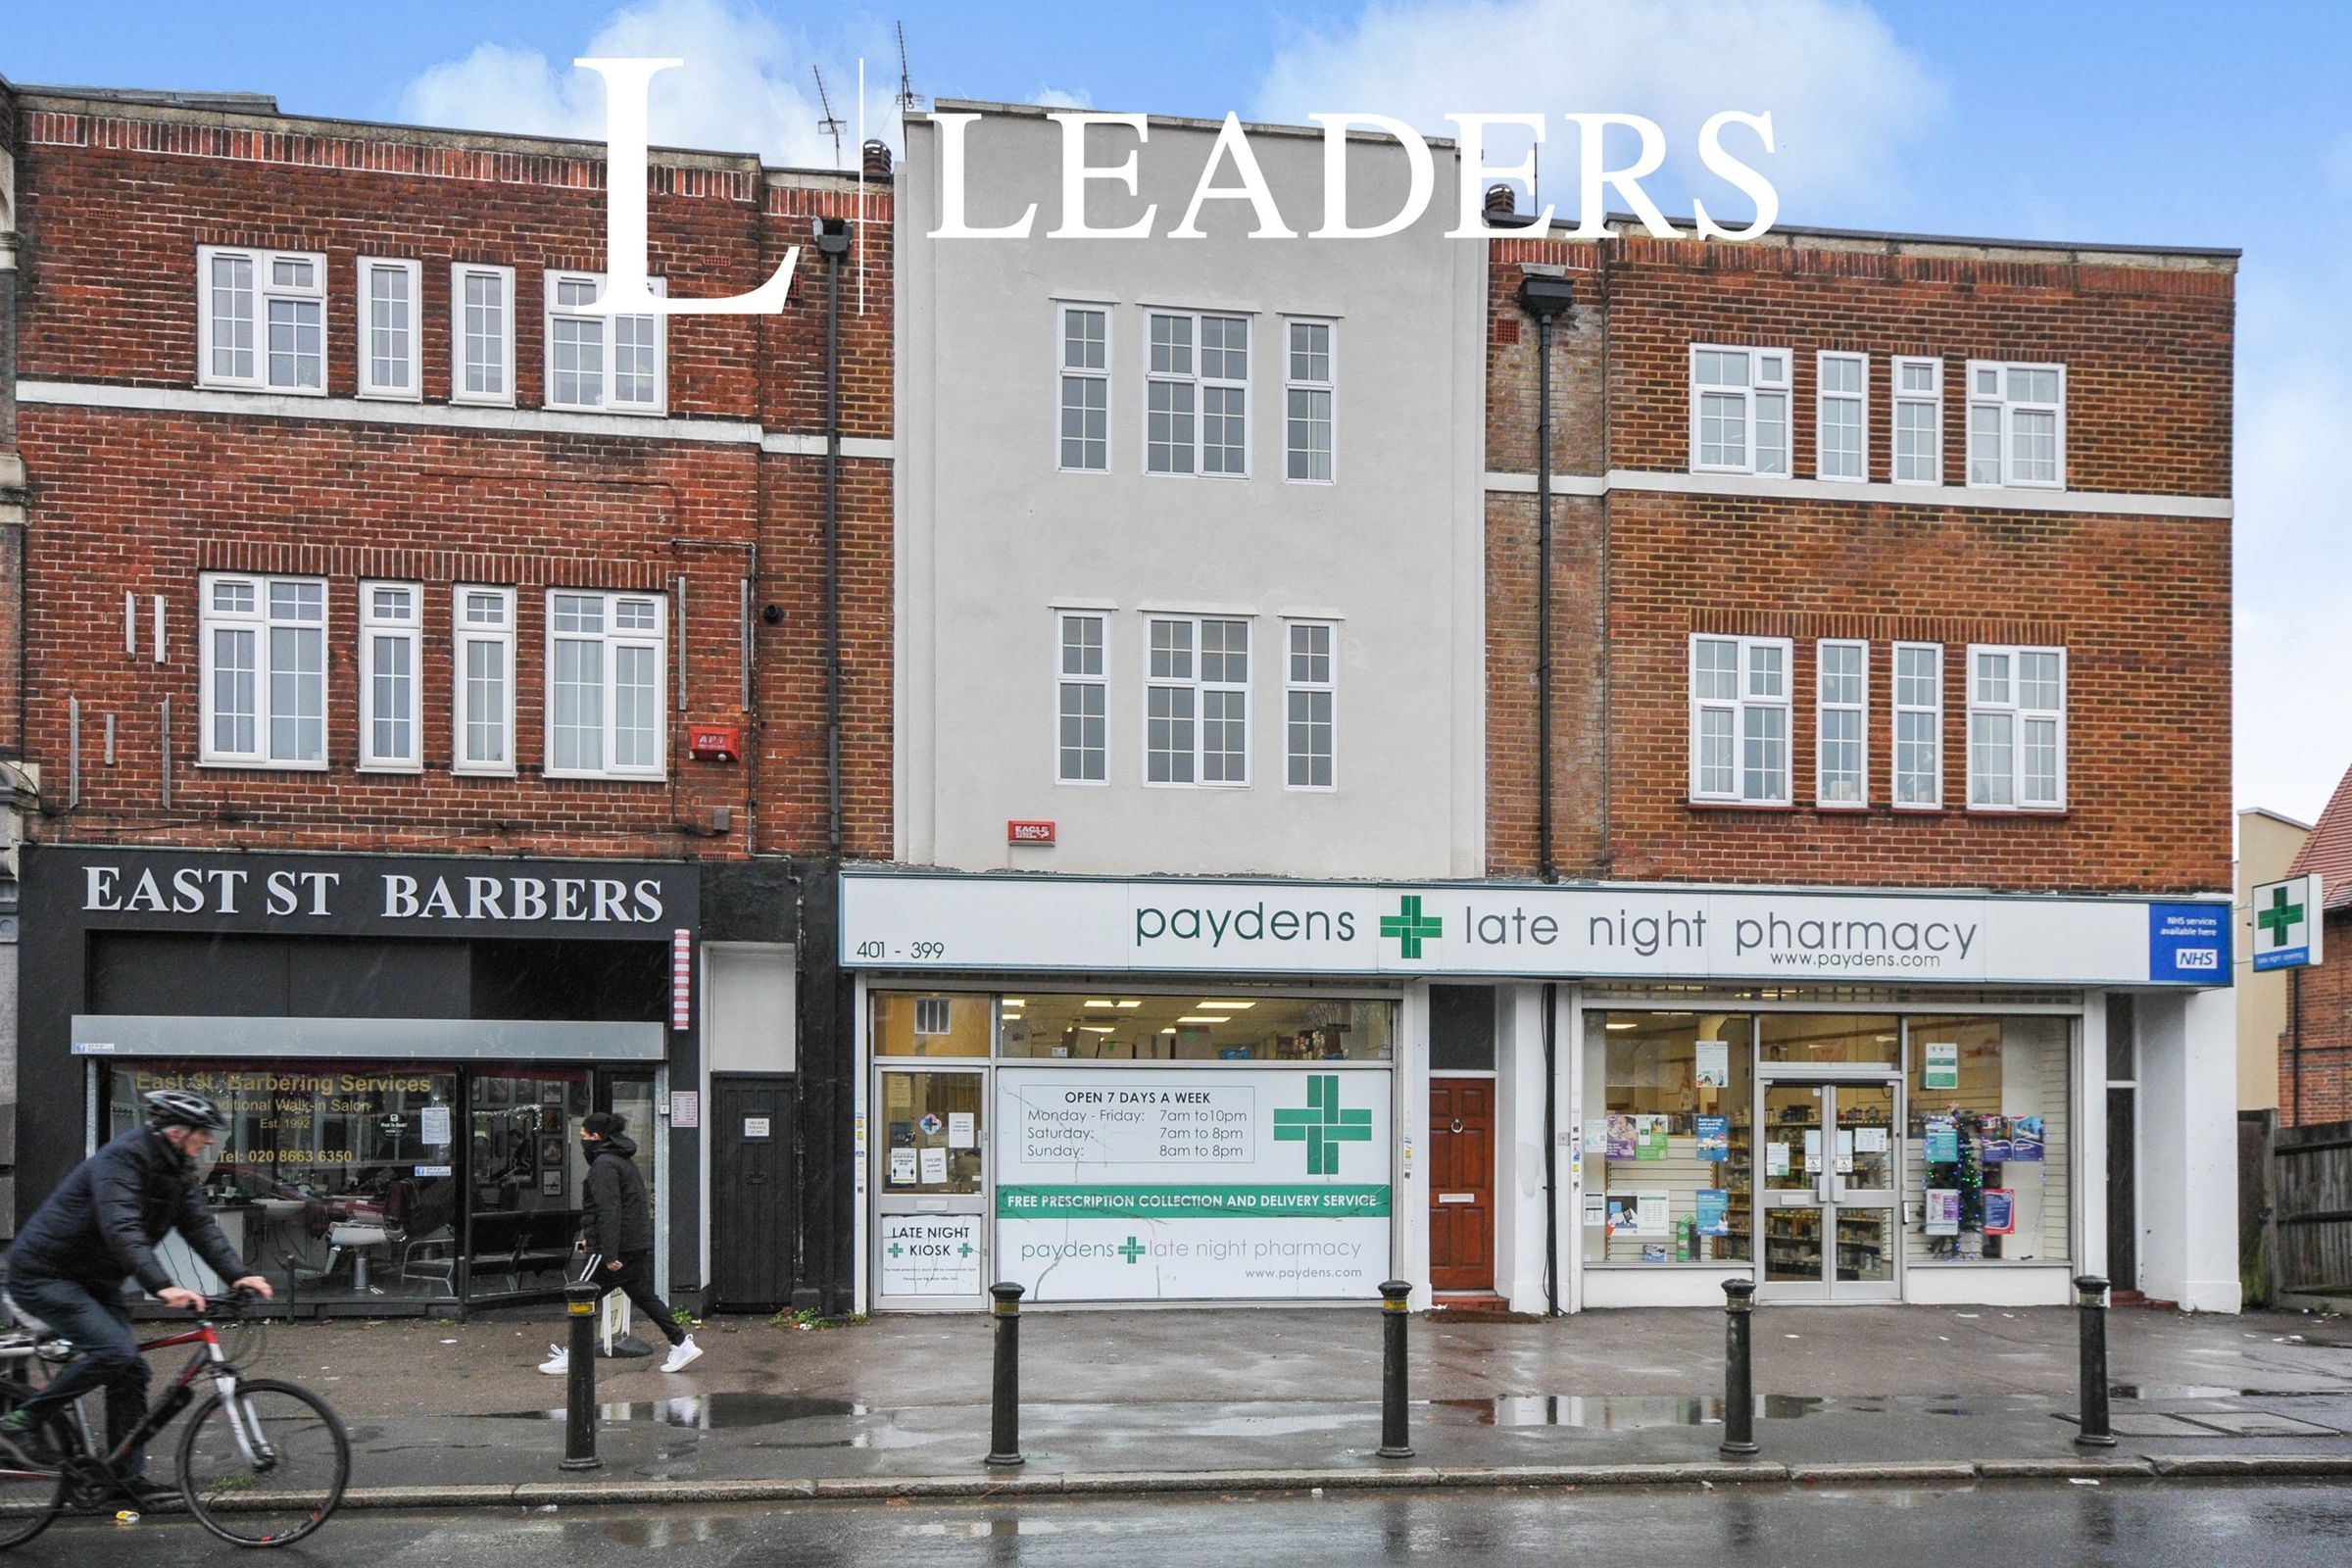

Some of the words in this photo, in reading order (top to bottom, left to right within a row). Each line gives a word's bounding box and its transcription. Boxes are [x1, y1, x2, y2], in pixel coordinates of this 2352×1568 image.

[81, 866, 247, 913] EAST
[267, 871, 340, 916] ST
[381, 874, 663, 924] BARBERS
[2167, 916, 2184, 925] NHS
[2186, 917, 2218, 926] services
[1136, 902, 1355, 948] paydens
[1466, 906, 1559, 945] late
[1590, 909, 1706, 956] night
[1737, 911, 1977, 958] pharmacy
[2160, 927, 2197, 936] available
[857, 941, 887, 959] 401
[910, 942, 945, 960] 399
[1770, 952, 1940, 969] www.paydens.com
[2180, 952, 2213, 965] NHS
[137, 1072, 183, 1091] East
[227, 1074, 334, 1095] Barbering
[340, 1075, 431, 1093] Services
[1064, 1092, 1102, 1103] OPEN
[1107, 1092, 1115, 1103] 7
[1119, 1092, 1156, 1103] DAYS
[1160, 1092, 1171, 1103] A
[1175, 1092, 1211, 1103] WEEK
[275, 1099, 326, 1111] Walk-in
[332, 1100, 370, 1112] Salon
[1027, 1109, 1087, 1123] Monday
[1100, 1109, 1146, 1123] Friday:
[1159, 1110, 1191, 1122] 7am
[284, 1118, 311, 1129] 1992
[1027, 1127, 1095, 1141] Saturday:
[1159, 1127, 1191, 1139] 7am
[1195, 1128, 1208, 1139] to
[1212, 1127, 1244, 1141] 8pm
[219, 1150, 244, 1162] Tel:
[248, 1150, 274, 1163] 020
[278, 1150, 314, 1163] 8663
[318, 1150, 353, 1163] 6350
[1027, 1145, 1084, 1158] Sunday:
[1159, 1145, 1191, 1156] 8am
[1195, 1146, 1208, 1156] to
[1212, 1145, 1244, 1158] 8pm
[1007, 1195, 1038, 1207] FREE
[1042, 1195, 1135, 1207] PRESCRIPTION
[1139, 1195, 1222, 1207] COLLECTION
[1226, 1195, 1257, 1207] AND
[1260, 1195, 1319, 1207] DELIVERY
[1323, 1195, 1376, 1207] SERVICE
[892, 1227, 922, 1239] LATE
[927, 1227, 970, 1239] NIGHT
[909, 1245, 951, 1256] KIOSK
[1021, 1240, 1114, 1262] paydens
[1150, 1240, 1189, 1256] late
[1196, 1239, 1249, 1261] night
[1254, 1239, 1362, 1261] pharmacy
[1245, 1267, 1362, 1279] www.paydens.com
